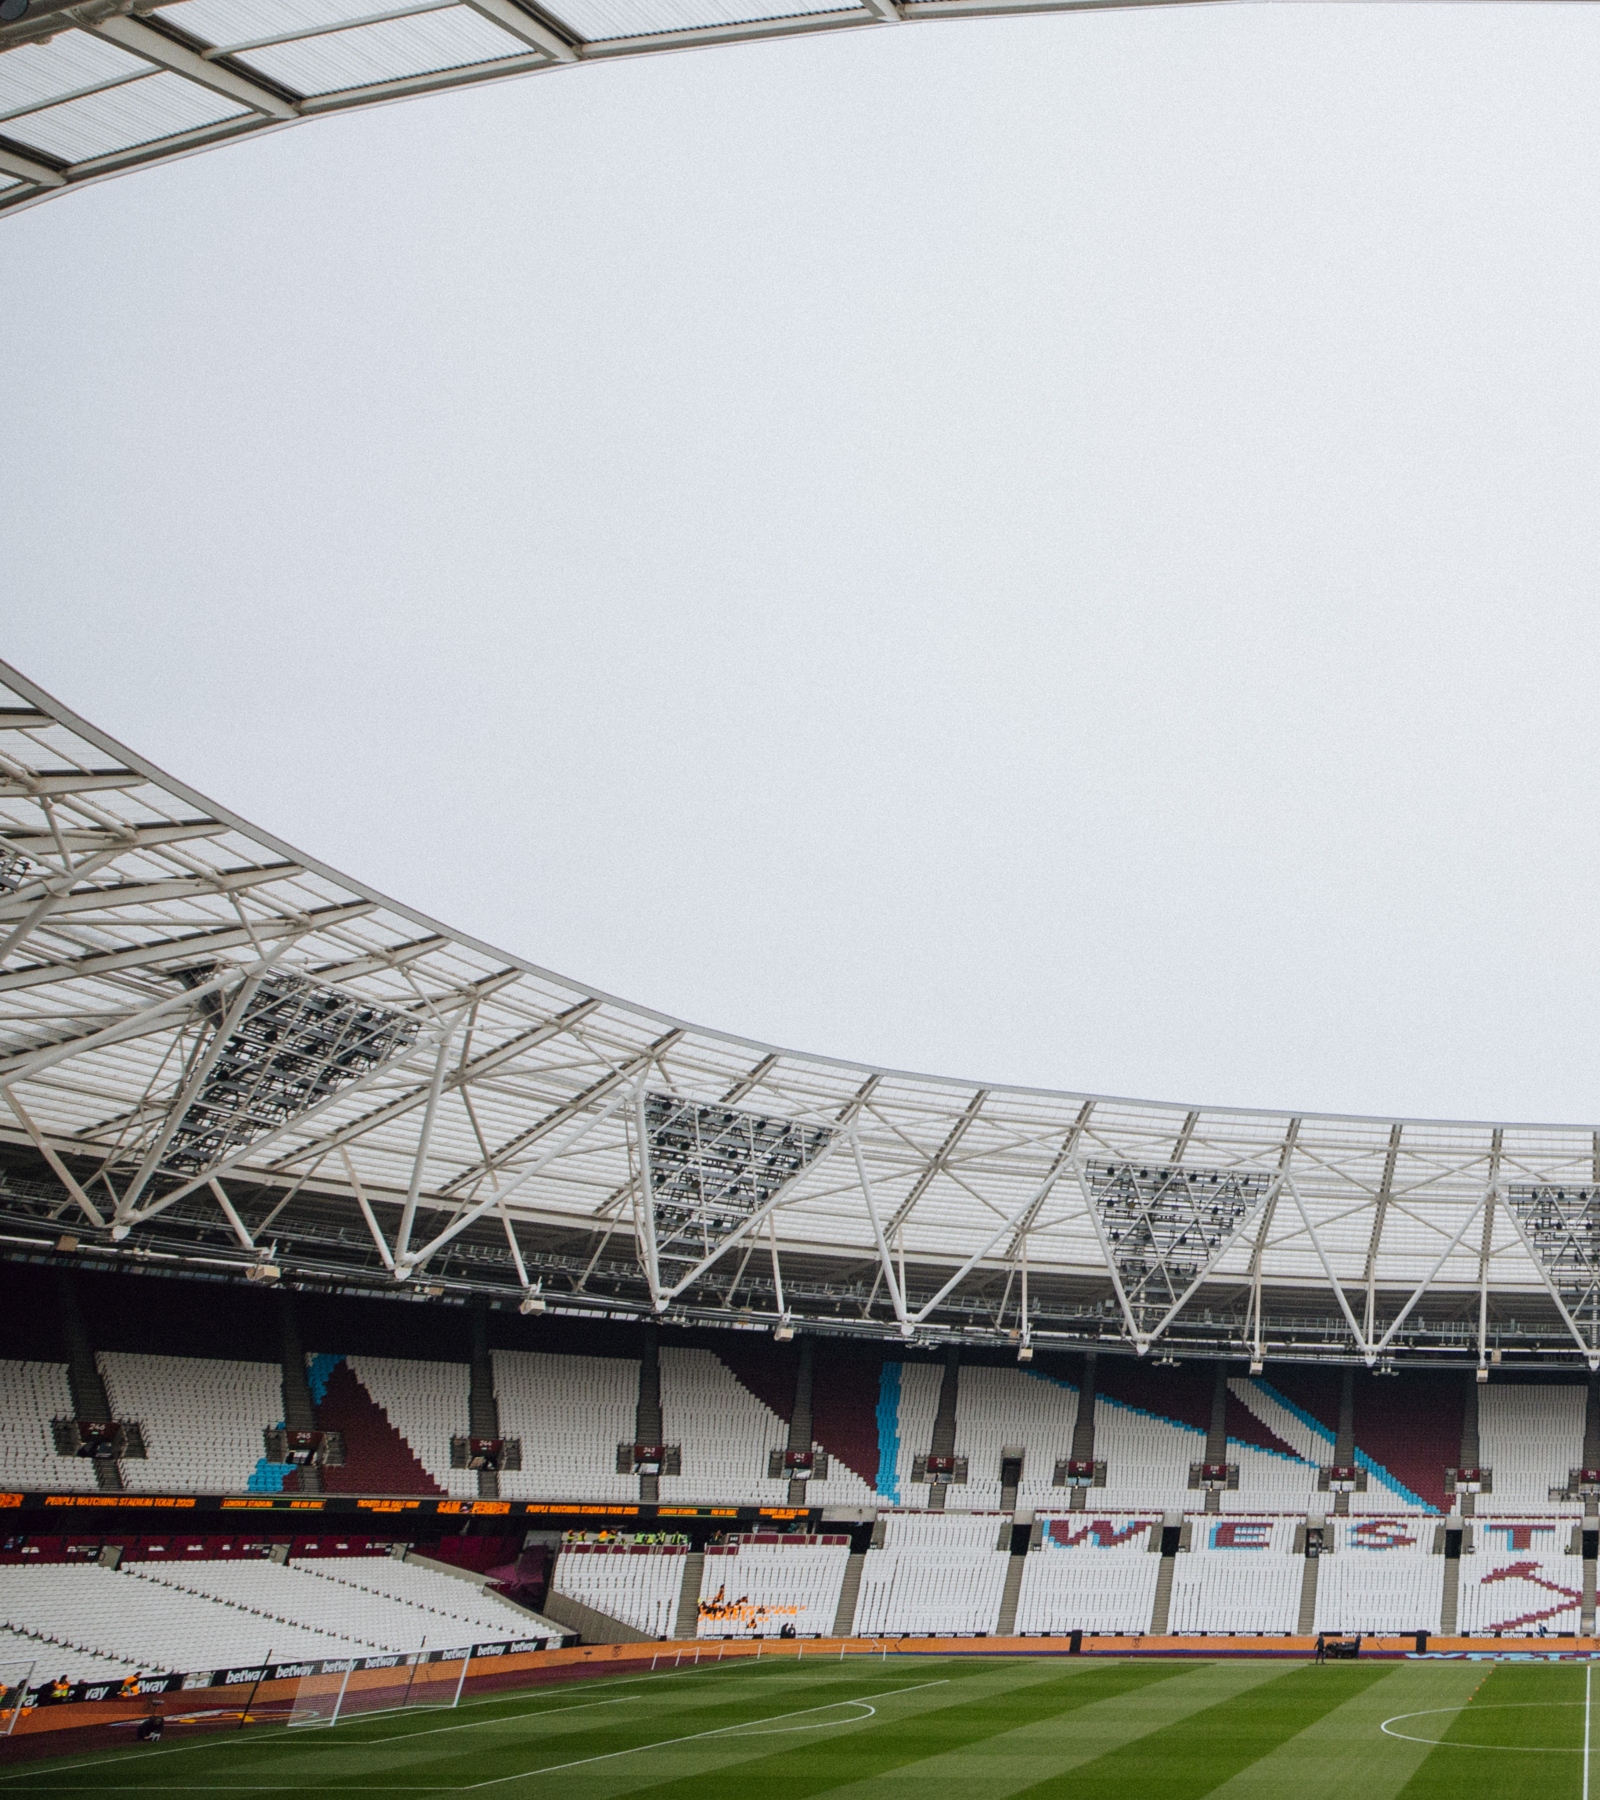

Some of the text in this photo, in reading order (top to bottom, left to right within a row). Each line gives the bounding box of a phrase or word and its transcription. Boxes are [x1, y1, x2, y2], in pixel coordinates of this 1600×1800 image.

[89, 1423, 105, 1431] 246
[45, 1496, 75, 1506] PEOPLE
[76, 1497, 117, 1506] WATCHING
[119, 1497, 153, 1507] STADIUM
[154, 1498, 174, 1507] TOUR
[437, 1501, 461, 1514] SAM
[477, 1644, 507, 1656] betway
[510, 1642, 538, 1652] betway
[364, 1655, 400, 1669] betway
[275, 1664, 315, 1679] betway
